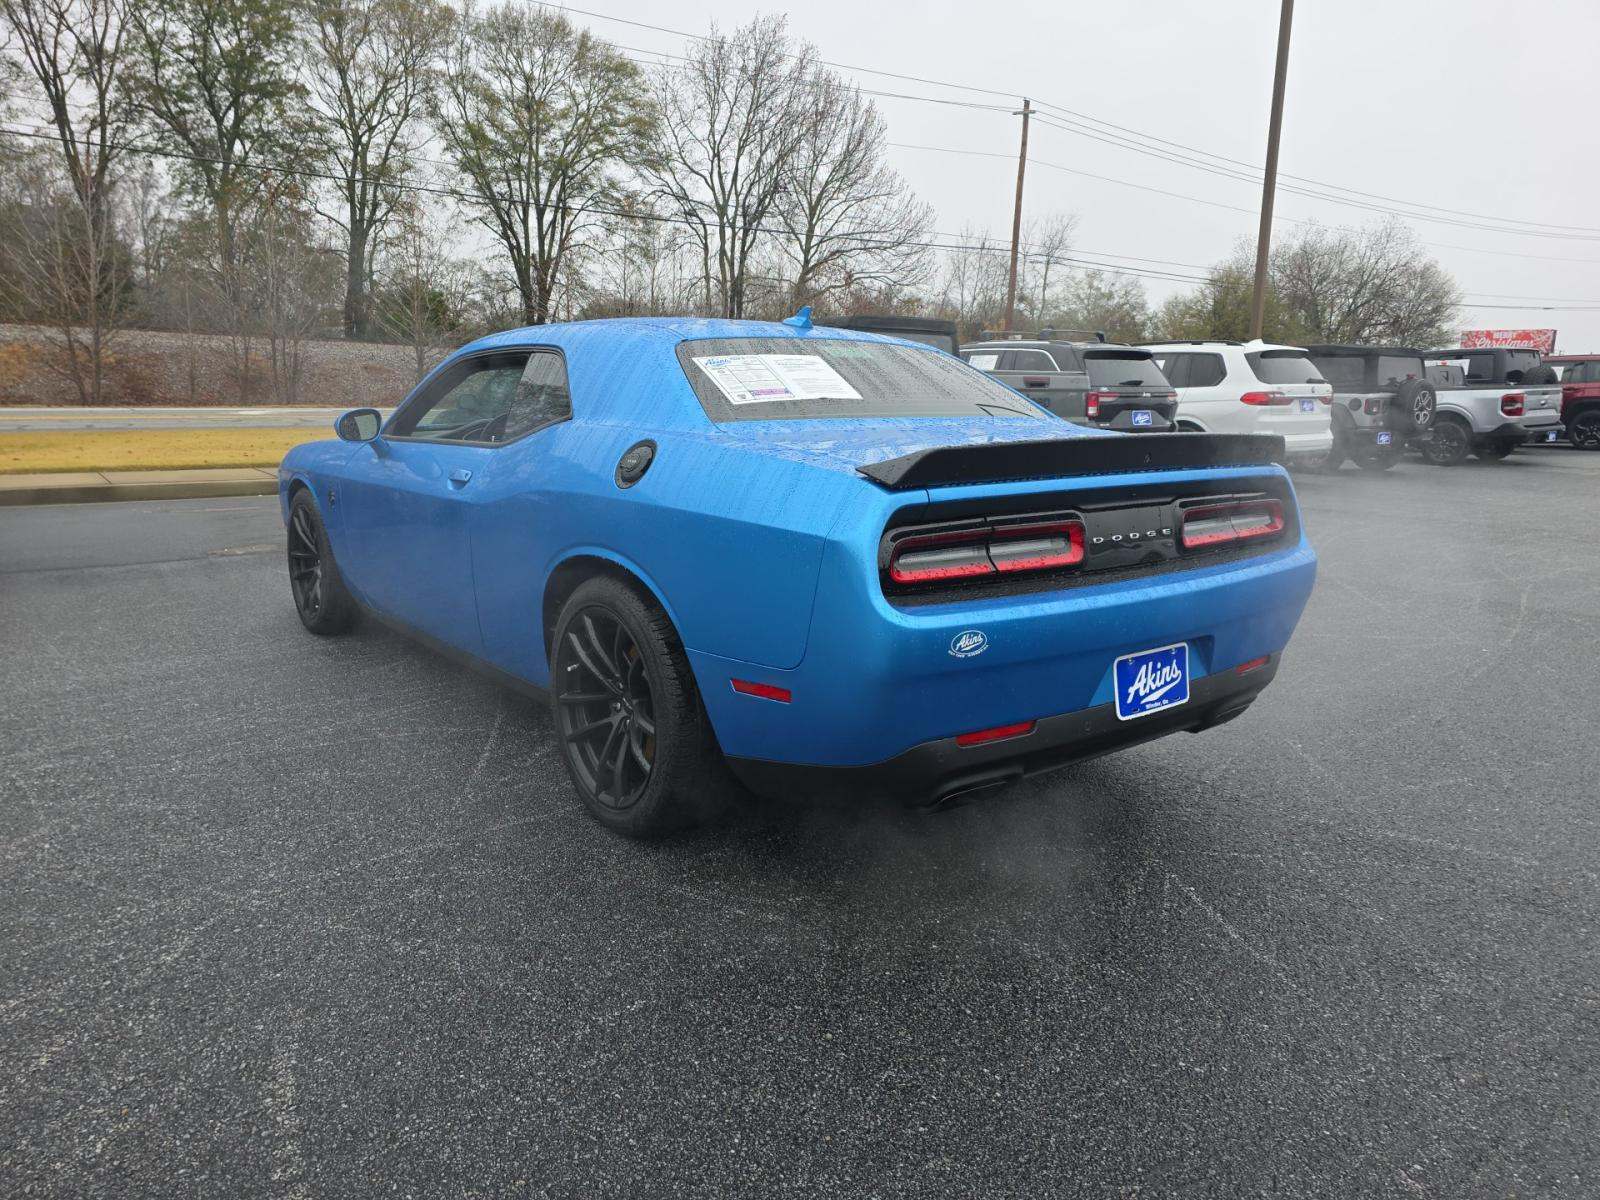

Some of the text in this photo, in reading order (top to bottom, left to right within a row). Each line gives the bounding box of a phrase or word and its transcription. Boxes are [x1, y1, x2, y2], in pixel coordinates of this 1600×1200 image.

[1475, 337, 1534, 349] Christmas
[1093, 528, 1171, 544] DODGE
[955, 634, 983, 651] Akins
[1127, 659, 1181, 704] Akins
